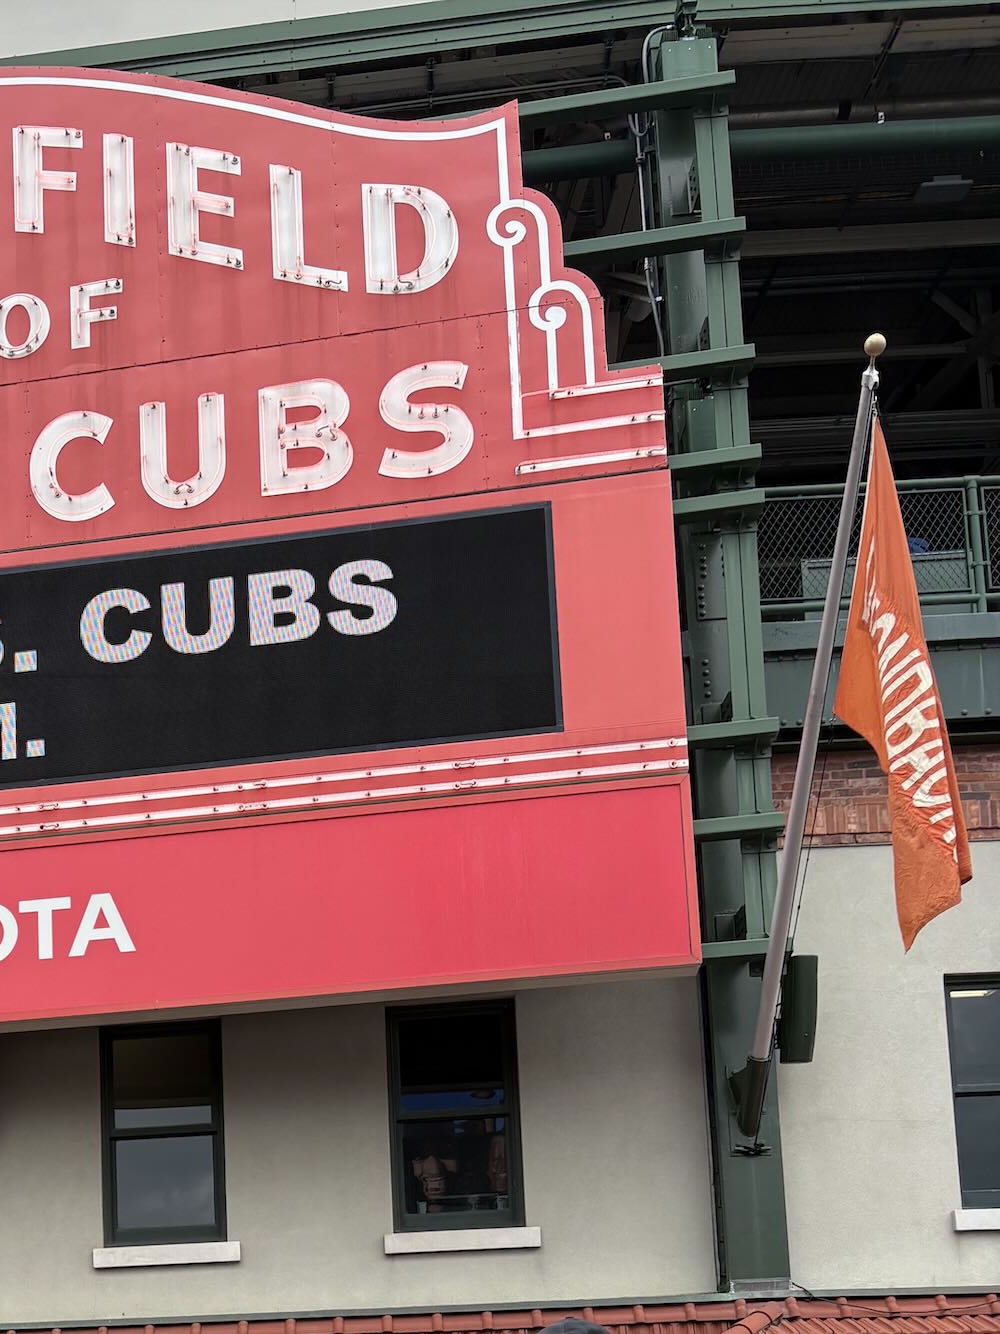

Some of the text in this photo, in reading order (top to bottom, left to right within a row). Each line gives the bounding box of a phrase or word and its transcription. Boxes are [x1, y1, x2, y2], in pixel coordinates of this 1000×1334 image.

[12, 124, 460, 295] FIELD
[29, 360, 475, 522] CUBS
[79, 558, 398, 665] CUBS
